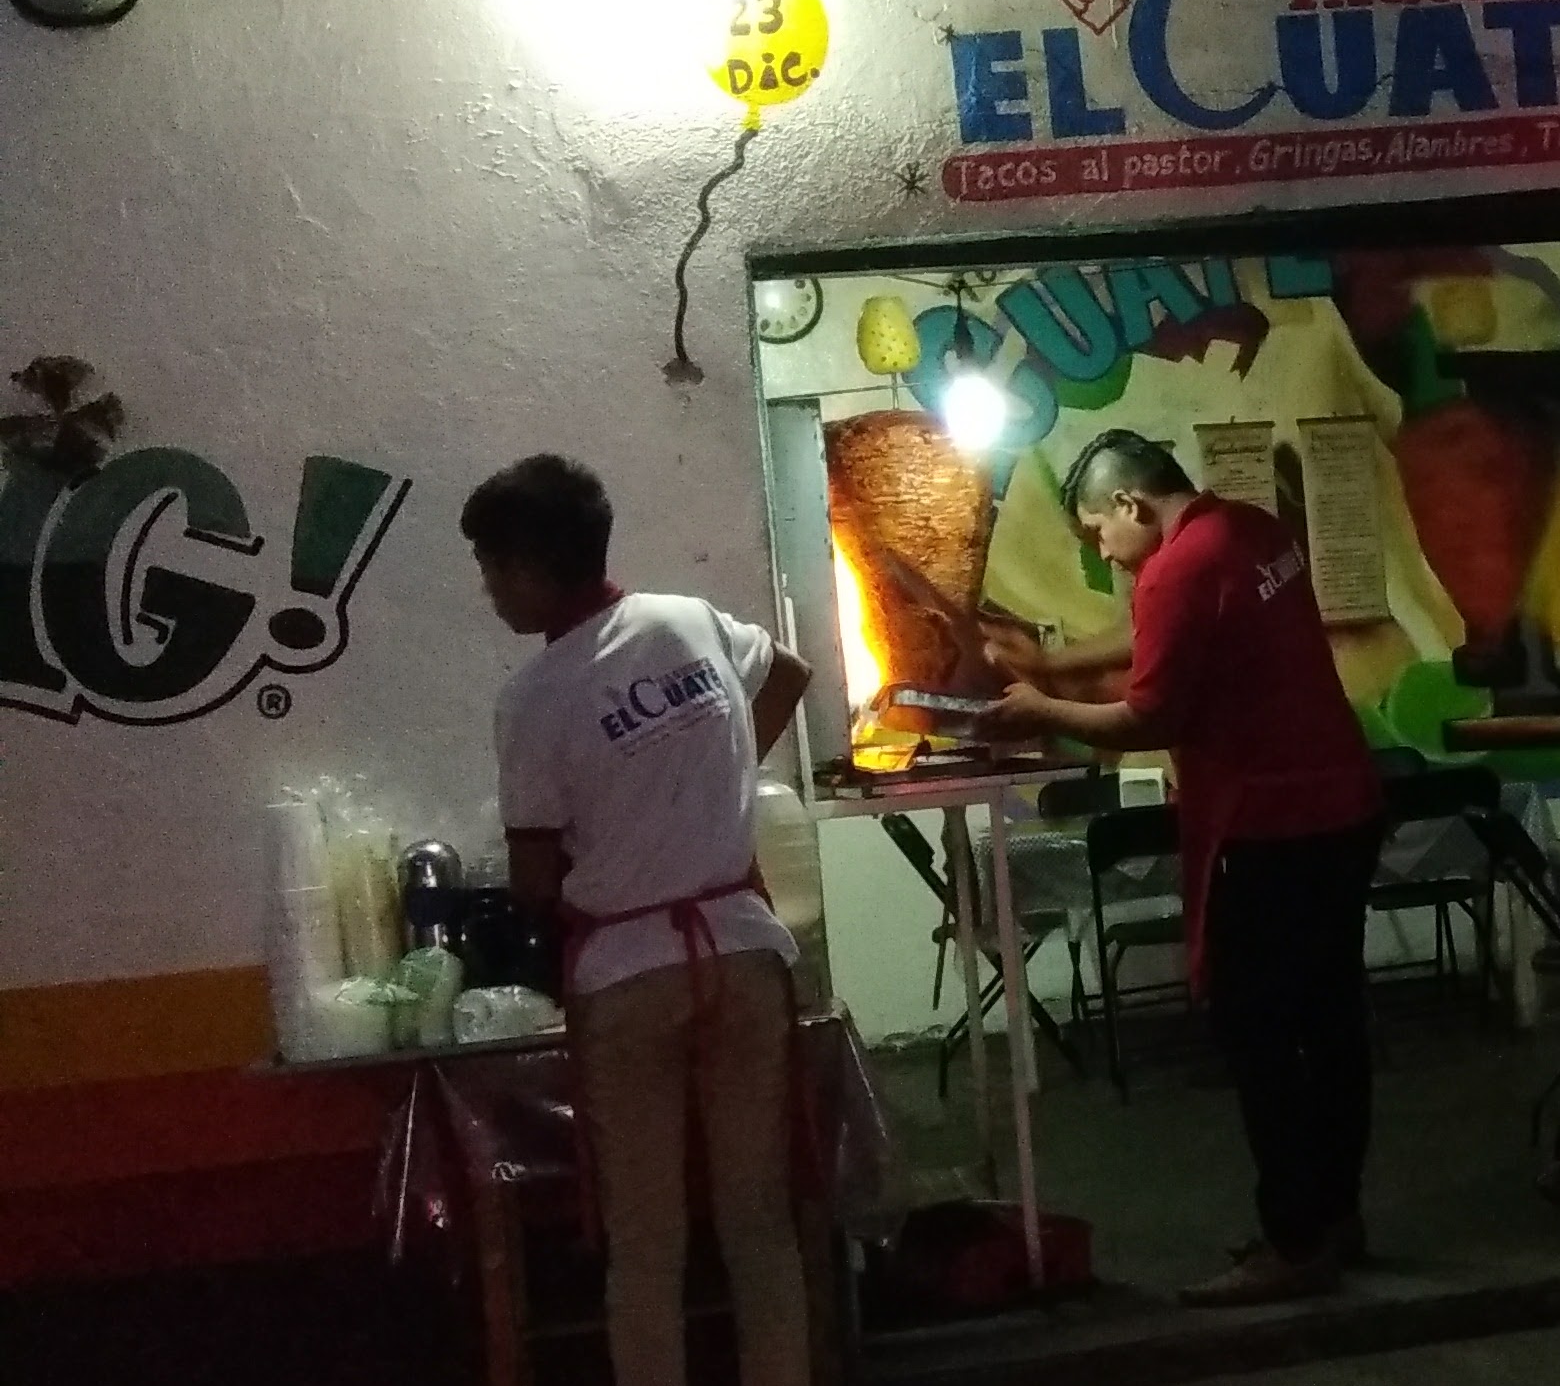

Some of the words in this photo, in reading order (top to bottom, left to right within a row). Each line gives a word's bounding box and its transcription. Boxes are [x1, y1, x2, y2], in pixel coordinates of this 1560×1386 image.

[949, 26, 1126, 144] EL
[952, 160, 1057, 195] Tacos
[1081, 149, 1109, 182] al
[600, 706, 642, 742] EL
